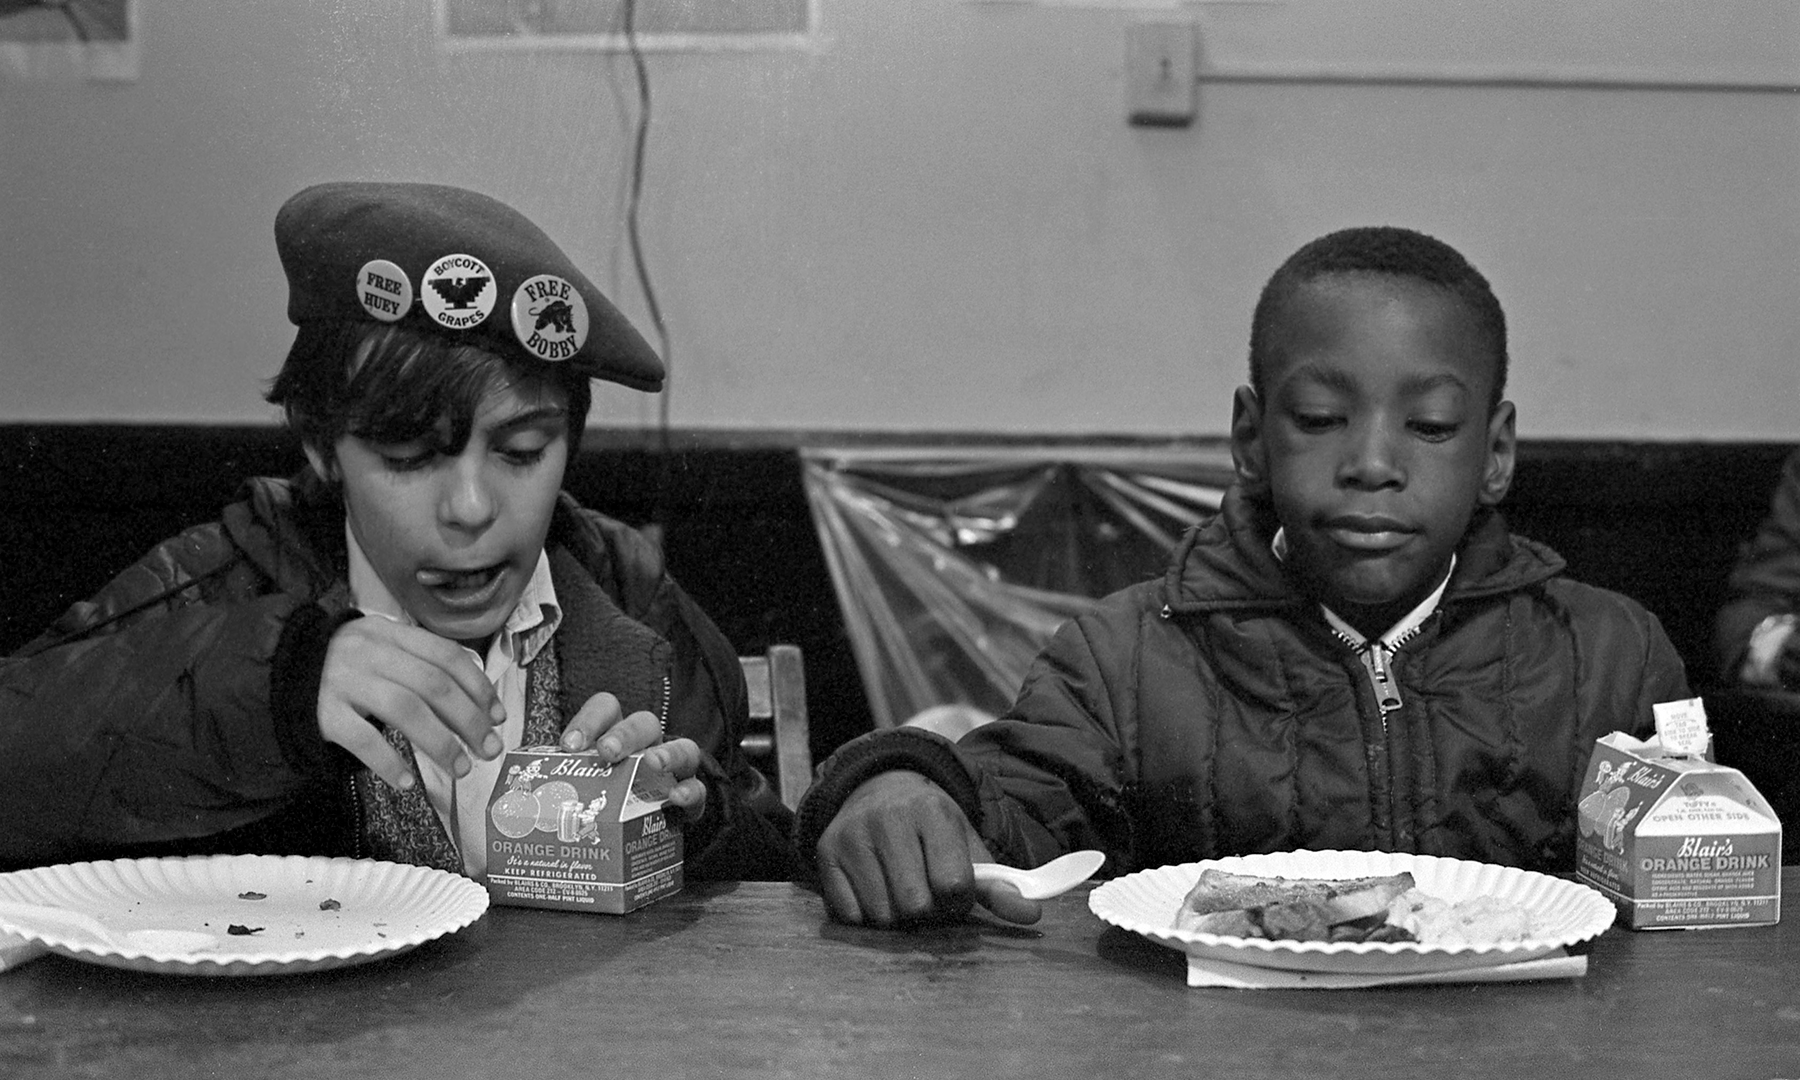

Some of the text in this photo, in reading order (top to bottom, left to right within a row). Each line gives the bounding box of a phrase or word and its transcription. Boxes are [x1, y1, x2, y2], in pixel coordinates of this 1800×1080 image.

[434, 258, 485, 276] BOYCOTT
[366, 272, 402, 295] FREE
[524, 279, 571, 302] FREE
[364, 292, 400, 315] HUEY
[437, 310, 485, 327] GRAPES
[526, 331, 579, 359] BOBBY
[550, 758, 613, 777] Blair's
[1630, 766, 1666, 789] Blair's
[1653, 812, 1750, 822] OPEN OTHER SIDE
[492, 840, 610, 860] ORANGE DRINK
[625, 834, 658, 854] ORANGE
[1677, 837, 1733, 857] Blair's
[507, 855, 522, 865] It's
[530, 859, 560, 868] natural
[568, 861, 593, 873] flavor
[1642, 854, 1769, 871] ORANGE DRINK
[504, 868, 597, 880] KEEP REFRIGERATED
[507, 891, 534, 899] CONTENTS
